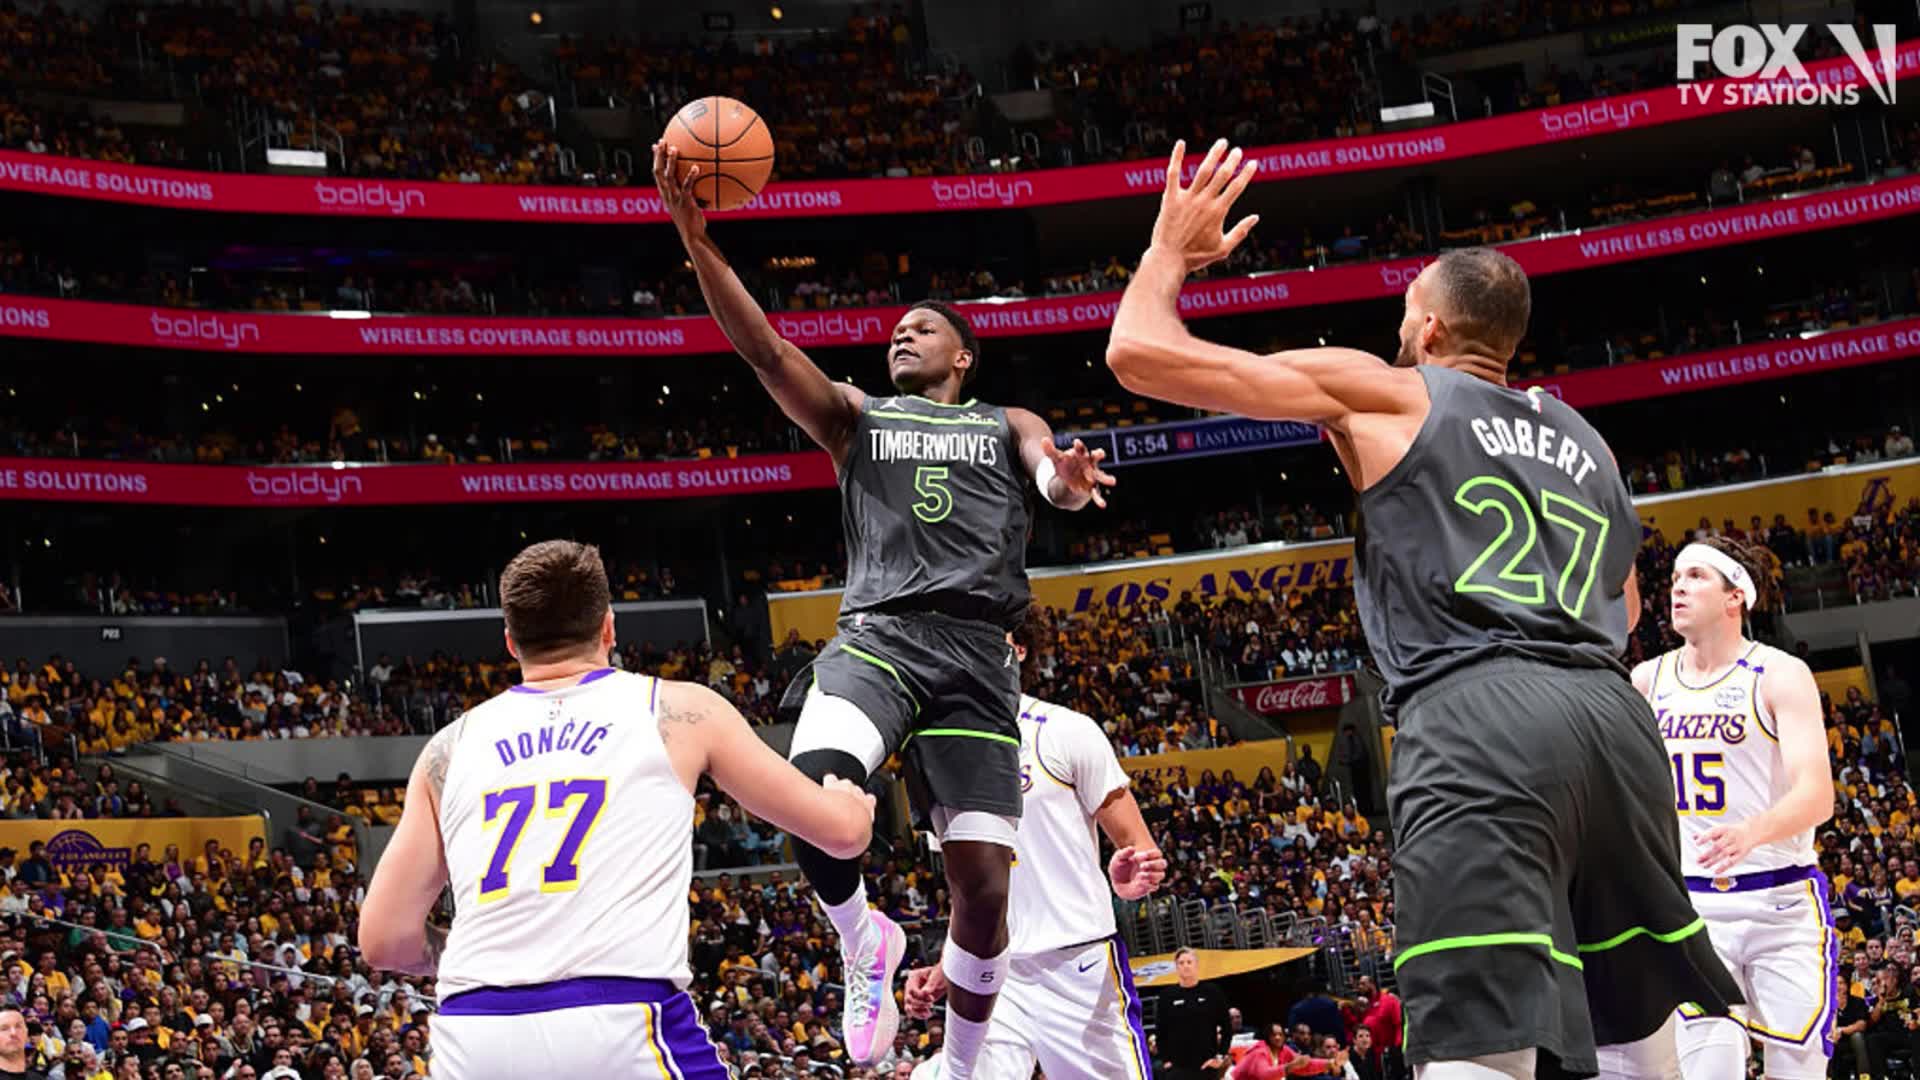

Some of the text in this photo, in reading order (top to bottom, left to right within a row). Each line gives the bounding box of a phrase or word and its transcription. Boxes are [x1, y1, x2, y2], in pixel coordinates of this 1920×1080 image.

[1540, 99, 1650, 134] boldyn
[1335, 135, 1446, 164] SOLUTIONS
[96, 172, 213, 201] SOLUTIONS
[315, 181, 425, 214] boldyn
[931, 178, 1033, 206] boldyn
[518, 195, 619, 215] WIRELESS
[1580, 184, 1920, 259] WIRELESS COVERAGE SOLUTIONS
[972, 303, 1069, 330] WIRELESS
[1179, 283, 1289, 312] SOLUTIONS
[150, 311, 260, 348] boldyn
[360, 326, 685, 347] WIRELESS COVERAGE SOLUTIONS
[777, 313, 882, 341] boldyn
[1661, 351, 1770, 385] WIRELESS
[1775, 333, 1889, 368] COVERAGE
[869, 429, 998, 467] TIMBERWOLVES
[1125, 434, 1169, 455] 5:54
[1471, 416, 1597, 485] GOBERT
[23, 470, 148, 493] SOLUTIONS
[248, 471, 363, 501] boldyn
[461, 465, 793, 493] WIRELESS COVERAGE SOLUTIONS
[912, 466, 953, 523] 5
[1454, 475, 1610, 619] 27
[1671, 752, 1728, 817] 15
[478, 776, 609, 904] 77
